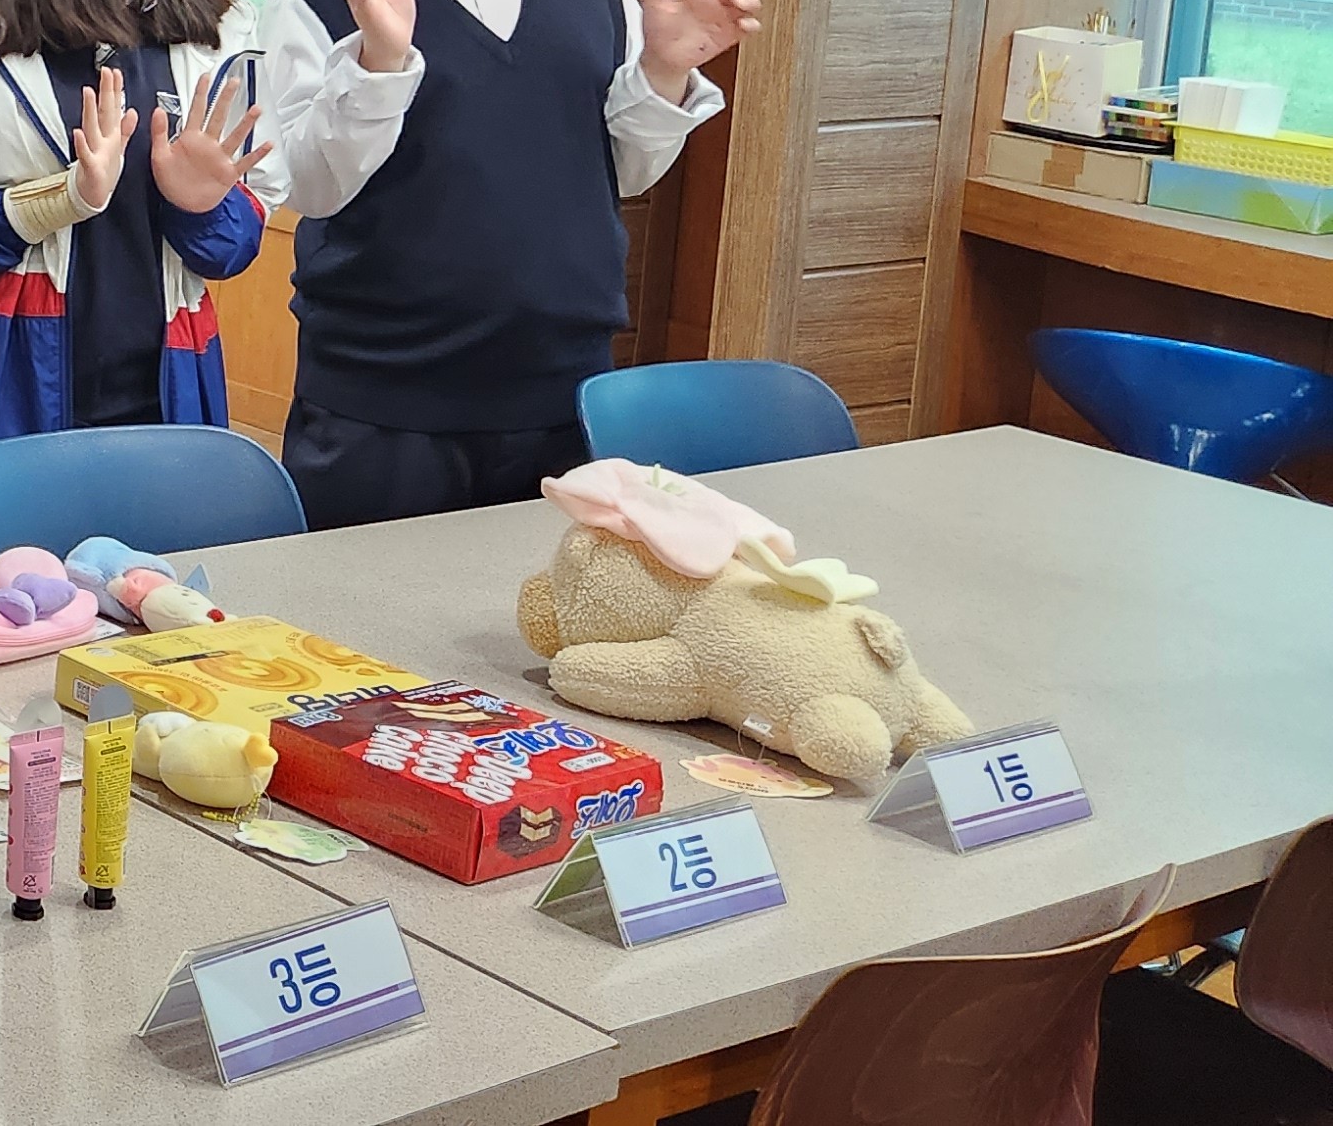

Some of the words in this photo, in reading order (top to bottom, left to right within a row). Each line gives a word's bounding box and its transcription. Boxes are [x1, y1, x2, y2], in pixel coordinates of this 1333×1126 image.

[471, 717, 597, 767] 오예스
[984, 749, 1033, 804] 1등
[572, 780, 644, 839] 오예스
[658, 832, 717, 892] 2등
[268, 943, 343, 1016] 3등
